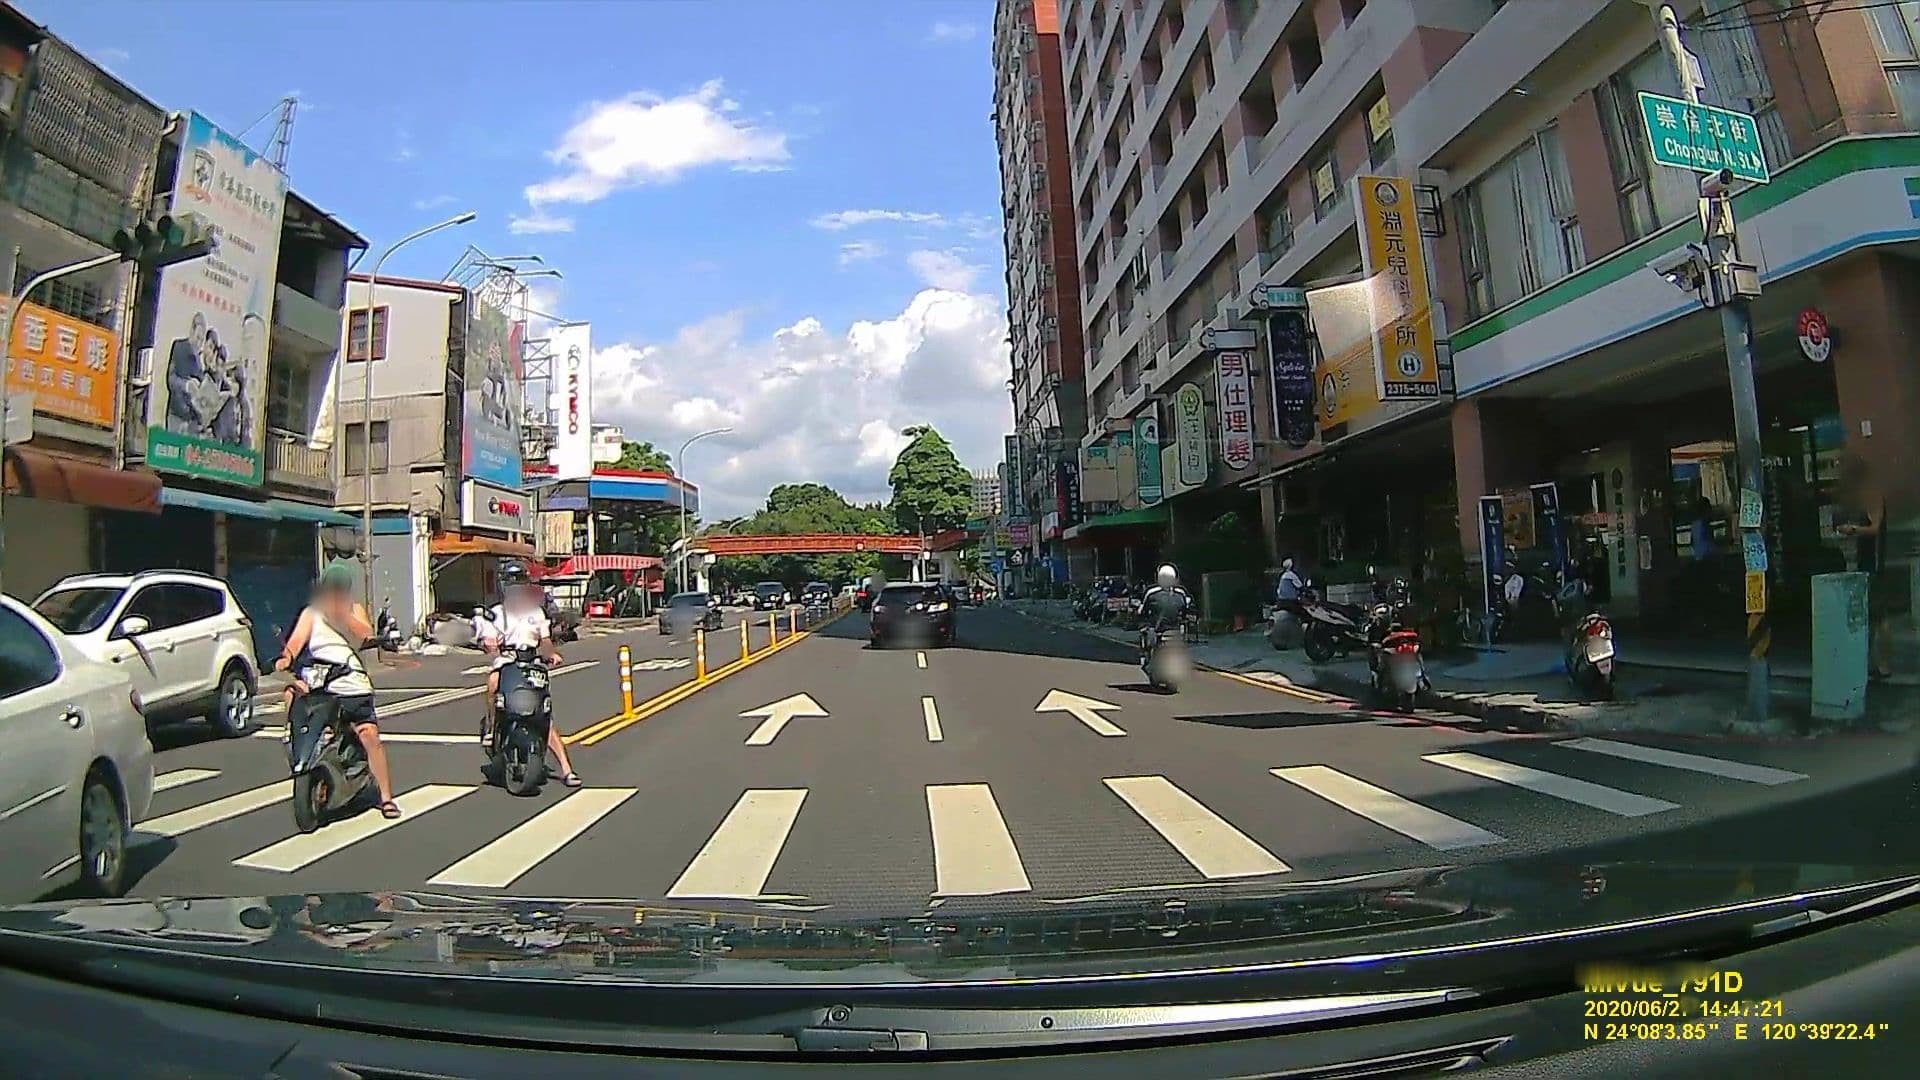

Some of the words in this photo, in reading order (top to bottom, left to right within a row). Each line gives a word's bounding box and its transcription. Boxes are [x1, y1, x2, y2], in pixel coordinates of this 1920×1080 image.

[1655, 103, 1748, 143] 崇倫北街
[1664, 137, 1719, 166] Chonglun
[1722, 148, 1737, 167] N.
[1380, 211, 1416, 346] 淵元兒科所
[1221, 354, 1250, 463] 男仕理髮
